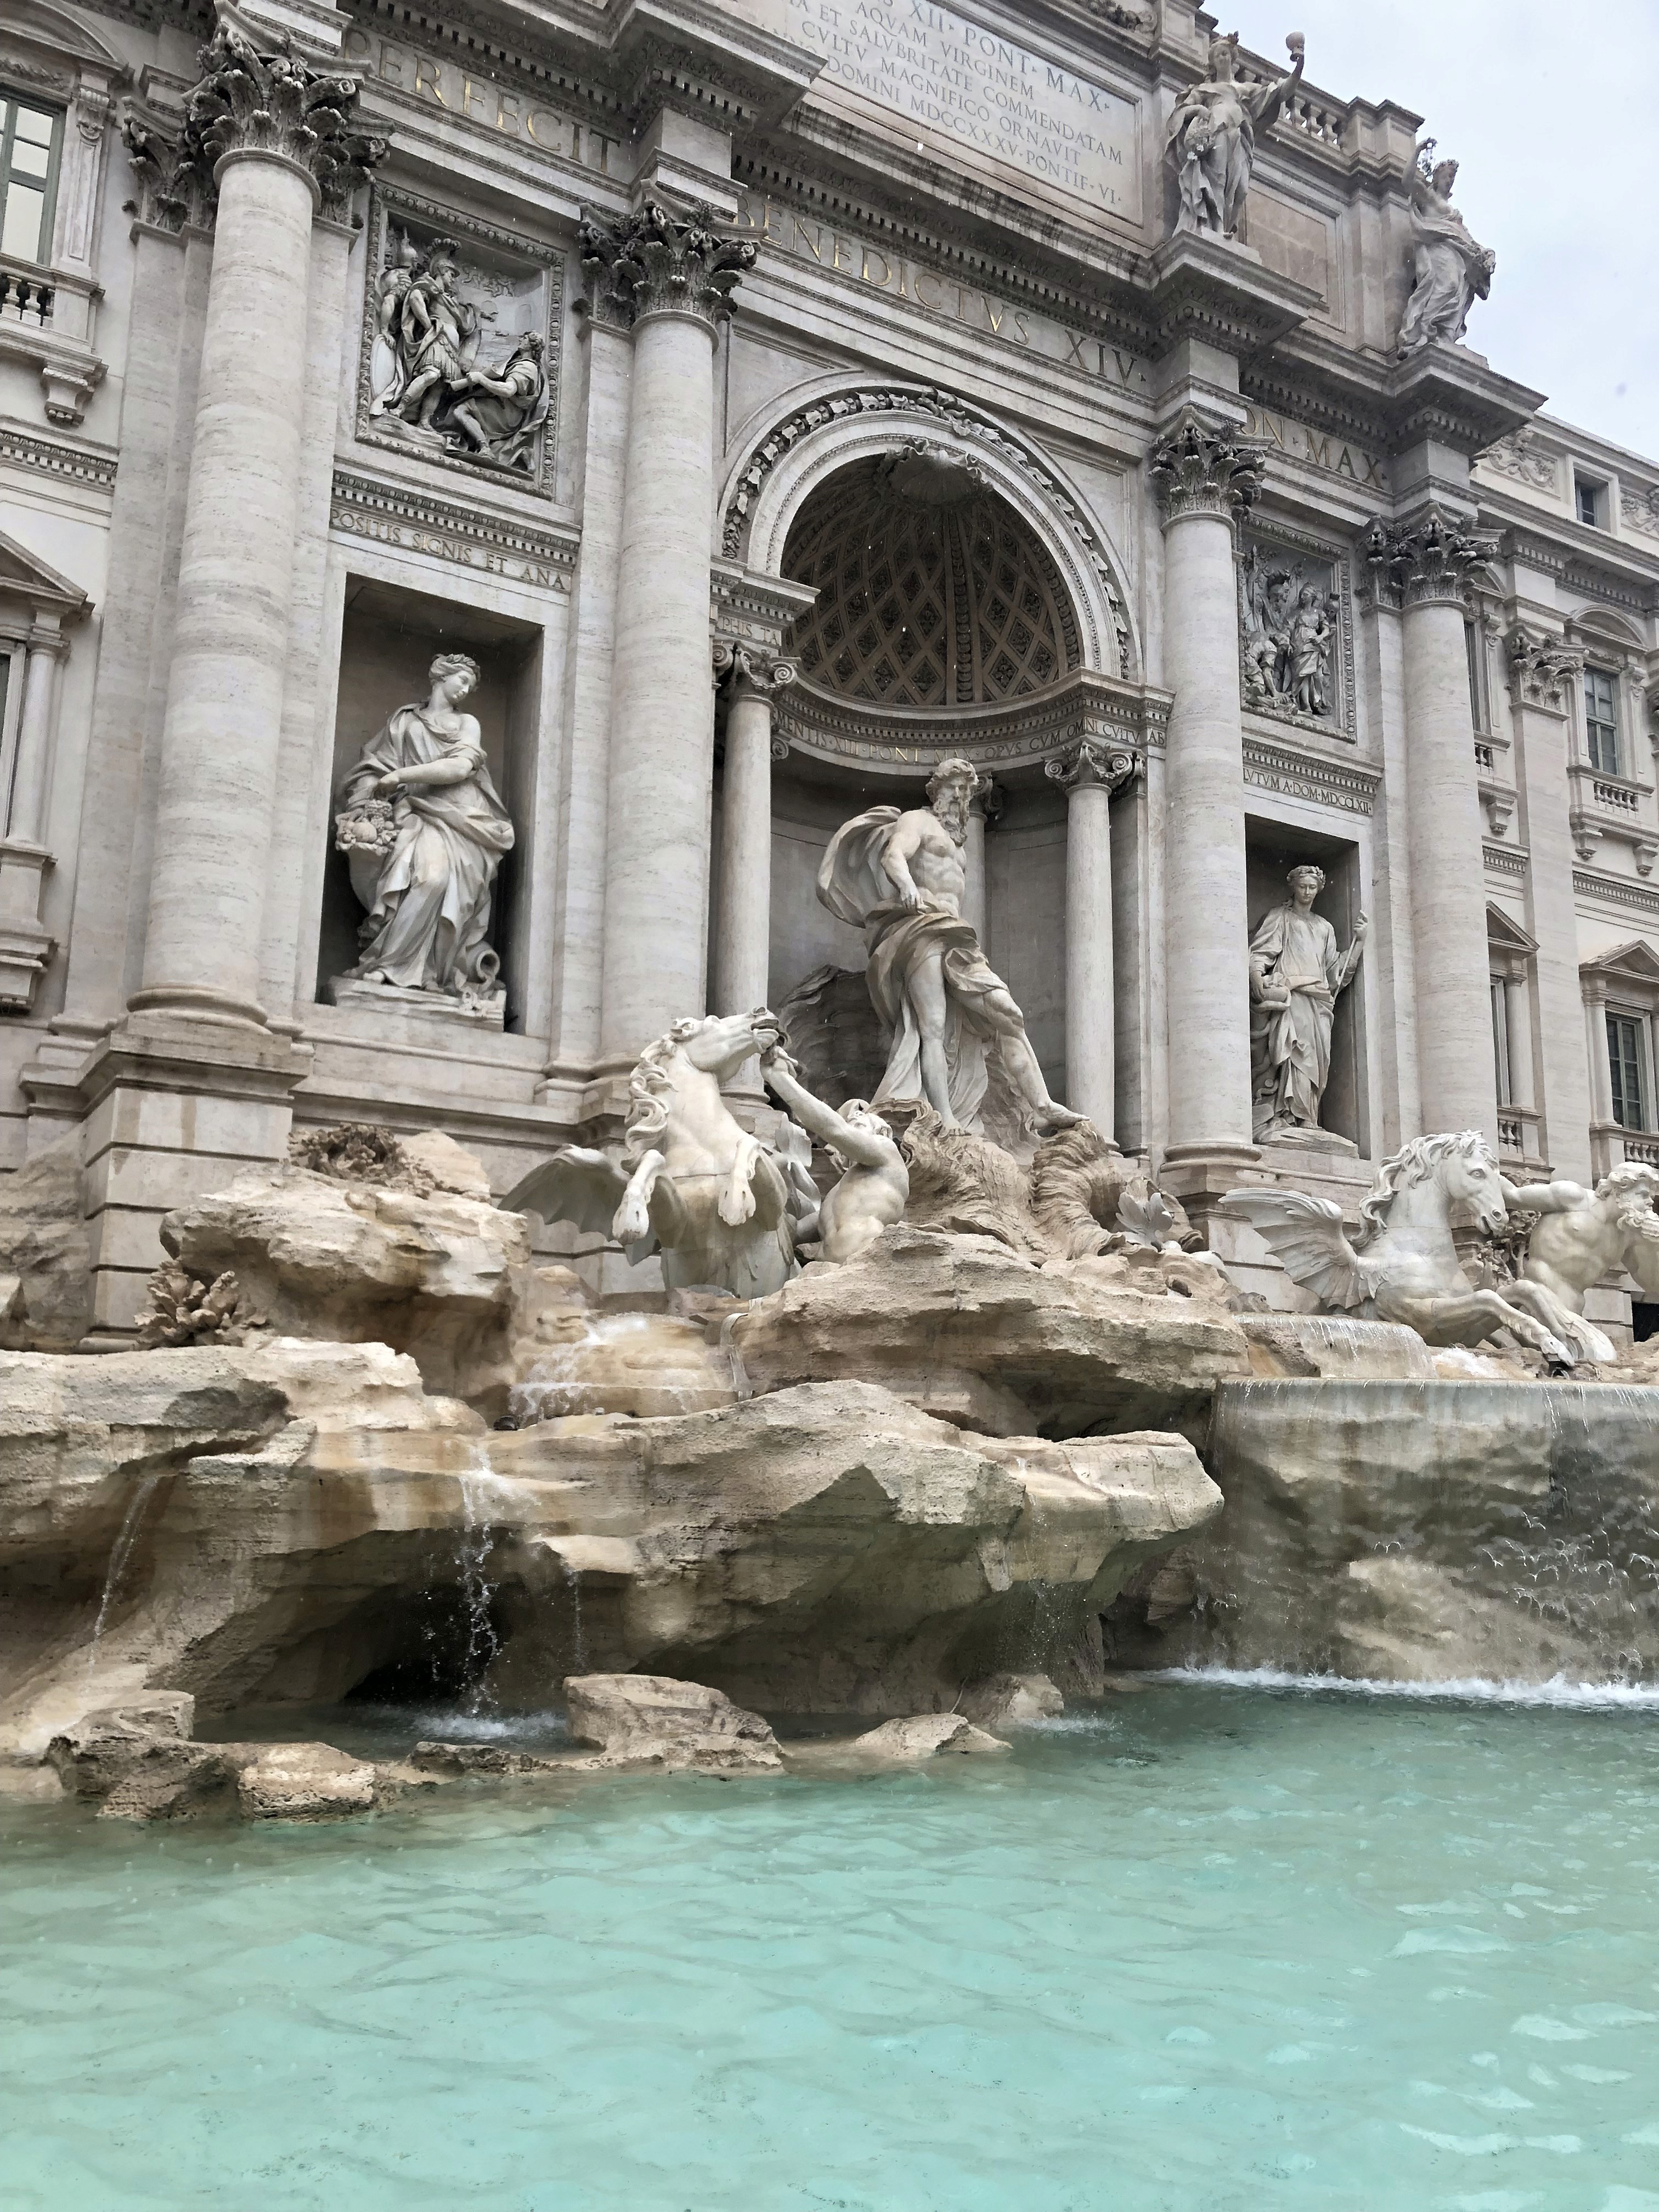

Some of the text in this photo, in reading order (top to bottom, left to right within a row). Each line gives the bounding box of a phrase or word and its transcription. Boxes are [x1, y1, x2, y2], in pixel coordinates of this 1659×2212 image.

[344, 27, 621, 173] PERFECIT
[802, 21, 867, 61] CVLTV
[880, 57, 990, 121] MAGNIFICO
[1000, 116, 1081, 166] ORNAVIT
[820, 4, 842, 27] ET
[850, 20, 973, 92] SALVBRITATE
[983, 86, 1122, 165] COMMENDATAM
[827, 54, 900, 103] DOMINI
[856, 2, 927, 48] AQVAM
[941, 41, 1035, 101] VIRGINEM
[733, 194, 1031, 347] BENEDICTVS
[329, 509, 566, 590] POSITIS SIGNIS ET ANA
[984, 741, 1022, 759] OPVS
[1029, 730, 1060, 751] CVM
[1067, 717, 1098, 737] OMNI
[1102, 724, 1140, 744] CVLTV
[1149, 731, 1165, 745] AB
